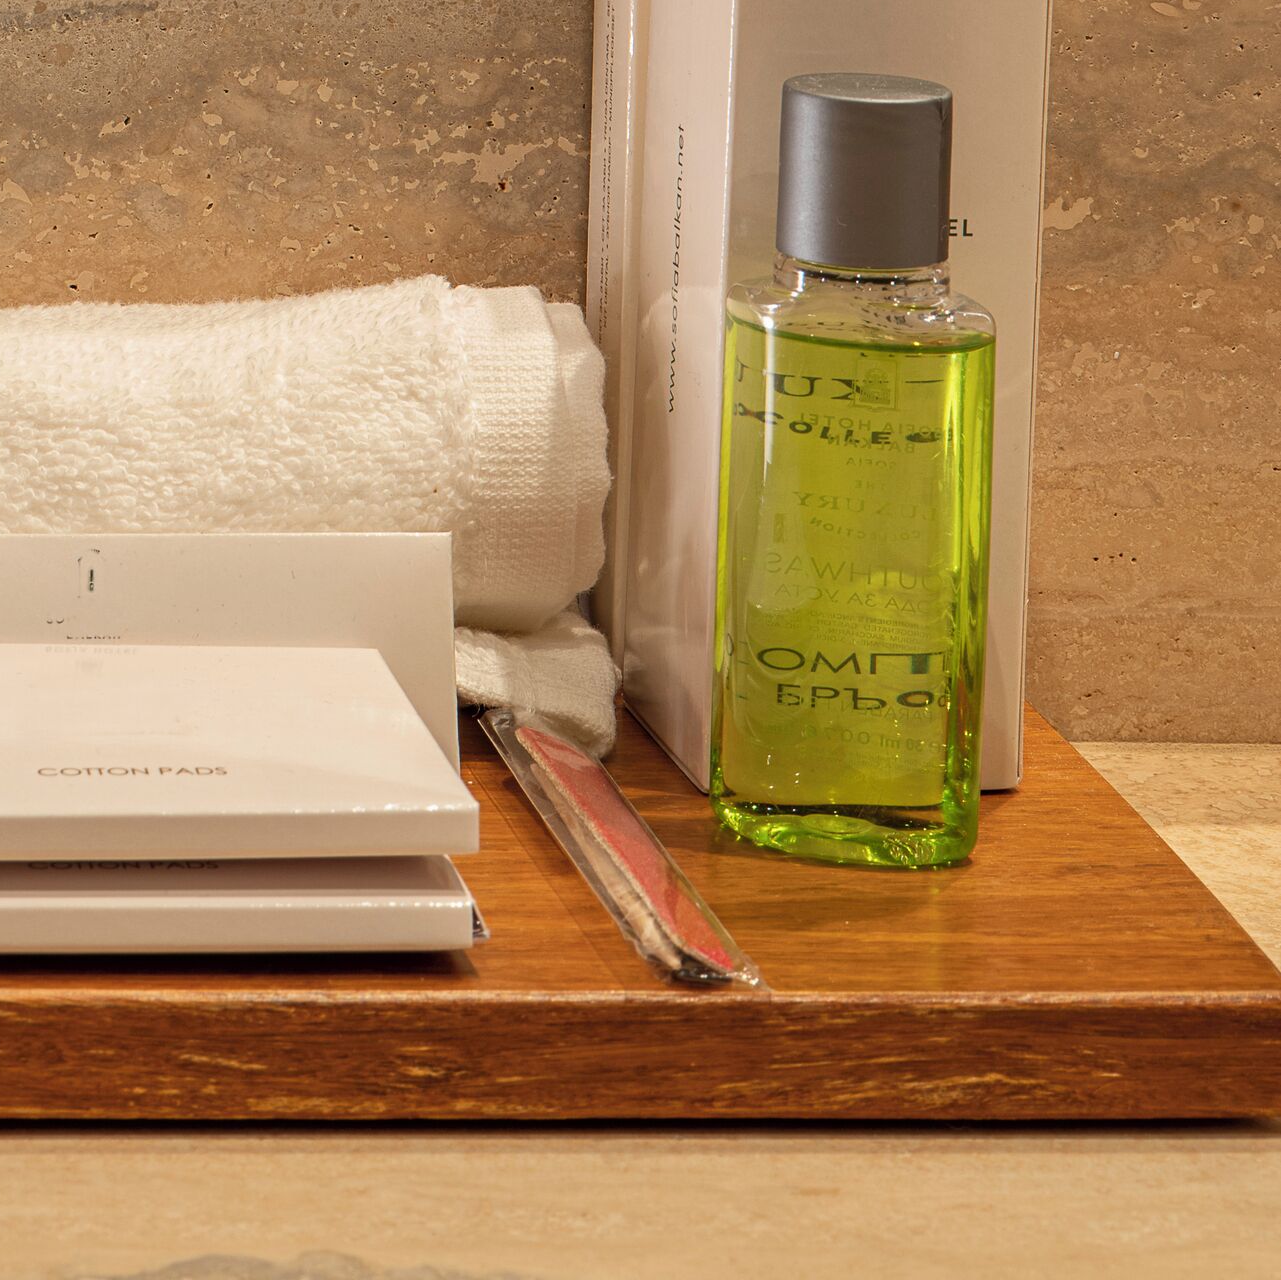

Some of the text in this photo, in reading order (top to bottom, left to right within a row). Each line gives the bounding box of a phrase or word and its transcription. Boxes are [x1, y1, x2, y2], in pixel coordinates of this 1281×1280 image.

[666, 122, 686, 414] www.sofiabalkan.net
[37, 766, 228, 776] COTTON PADS
